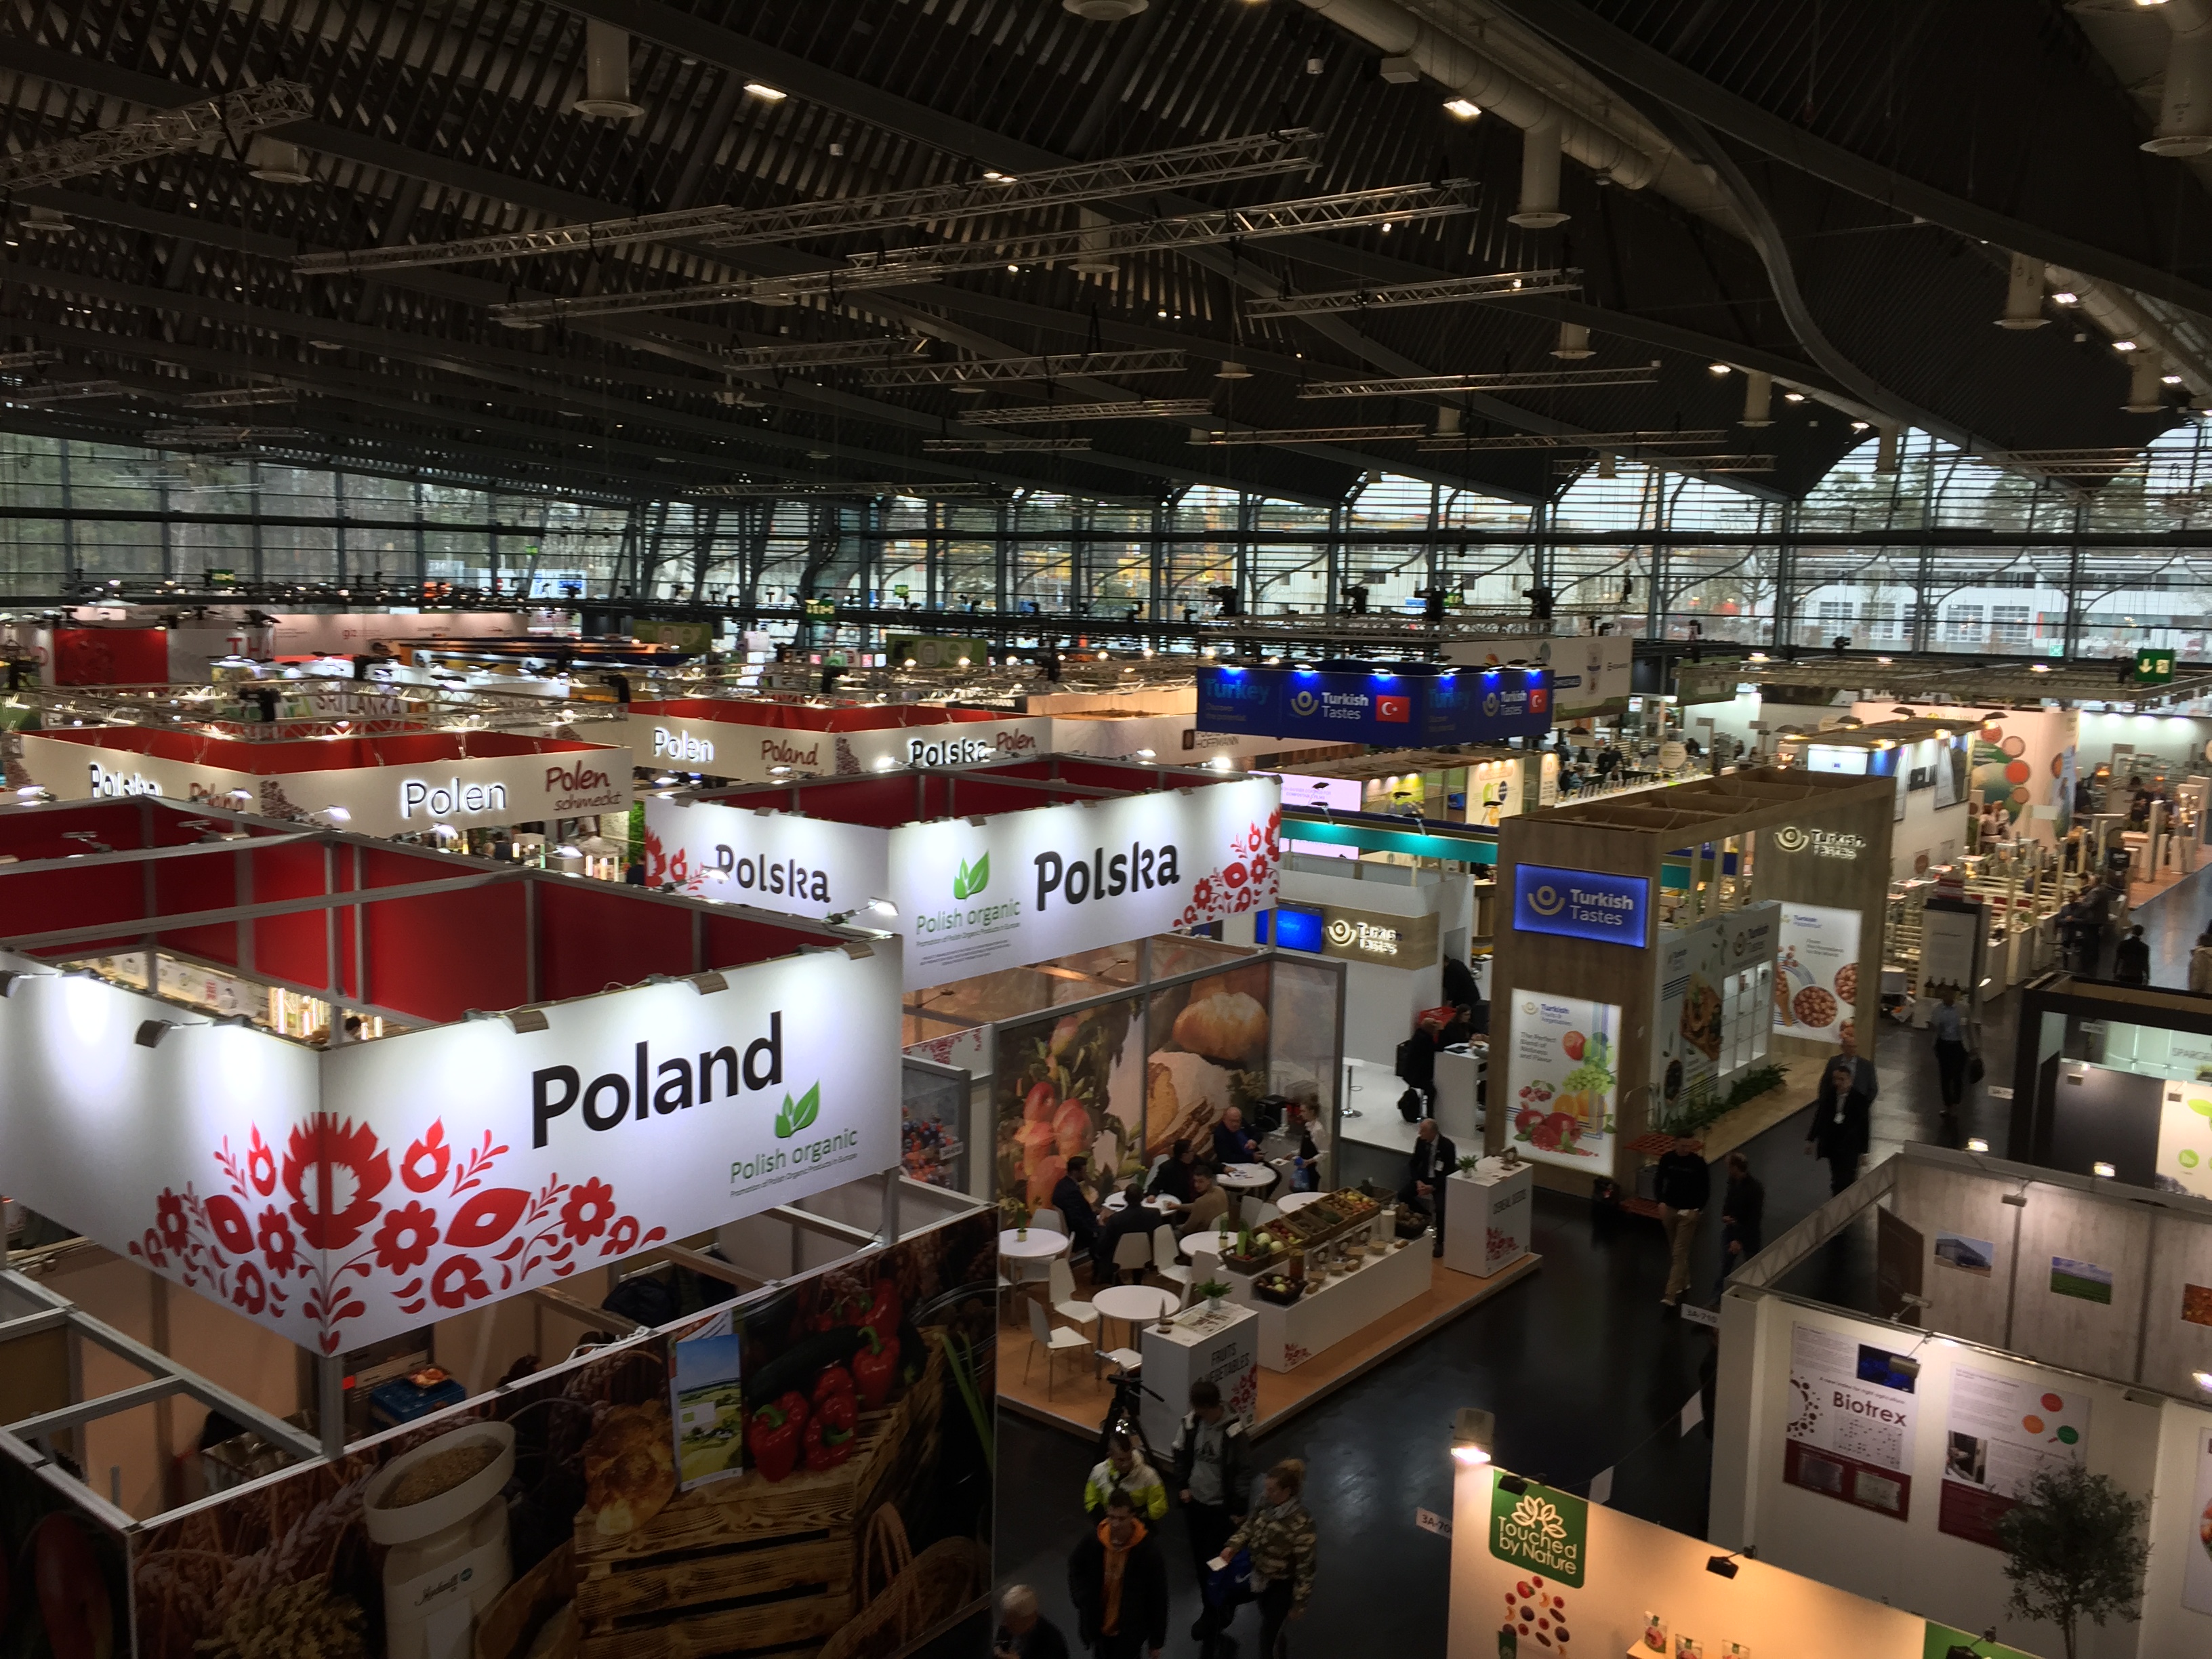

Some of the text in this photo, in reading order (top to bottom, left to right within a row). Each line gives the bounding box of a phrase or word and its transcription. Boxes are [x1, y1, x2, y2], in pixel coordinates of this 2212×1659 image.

[1206, 678, 1270, 705] Turkey
[1322, 692, 1369, 707] Turkish
[1500, 690, 1528, 702] Turkish
[1322, 705, 1361, 720] Tastes
[1500, 704, 1523, 716] Tastes
[653, 726, 714, 762] Polen
[761, 739, 819, 766] Poland
[908, 737, 988, 767] Polska
[996, 728, 1036, 752] Polen
[546, 760, 612, 793] Polen
[402, 777, 506, 818] Polen
[553, 790, 623, 811] schmeckt
[715, 844, 832, 903] Polska
[1034, 841, 1181, 912] Polska
[1569, 888, 1634, 911] Turkish
[916, 898, 1021, 935] Polish organic
[1569, 905, 1624, 926] Tastes
[532, 1010, 783, 1149] Poland
[730, 1128, 859, 1184] Polish organic
[1832, 1391, 1906, 1427] Biotrex
[1497, 1515, 1578, 1559] Touched
[1499, 1532, 1577, 1575] by Nature
